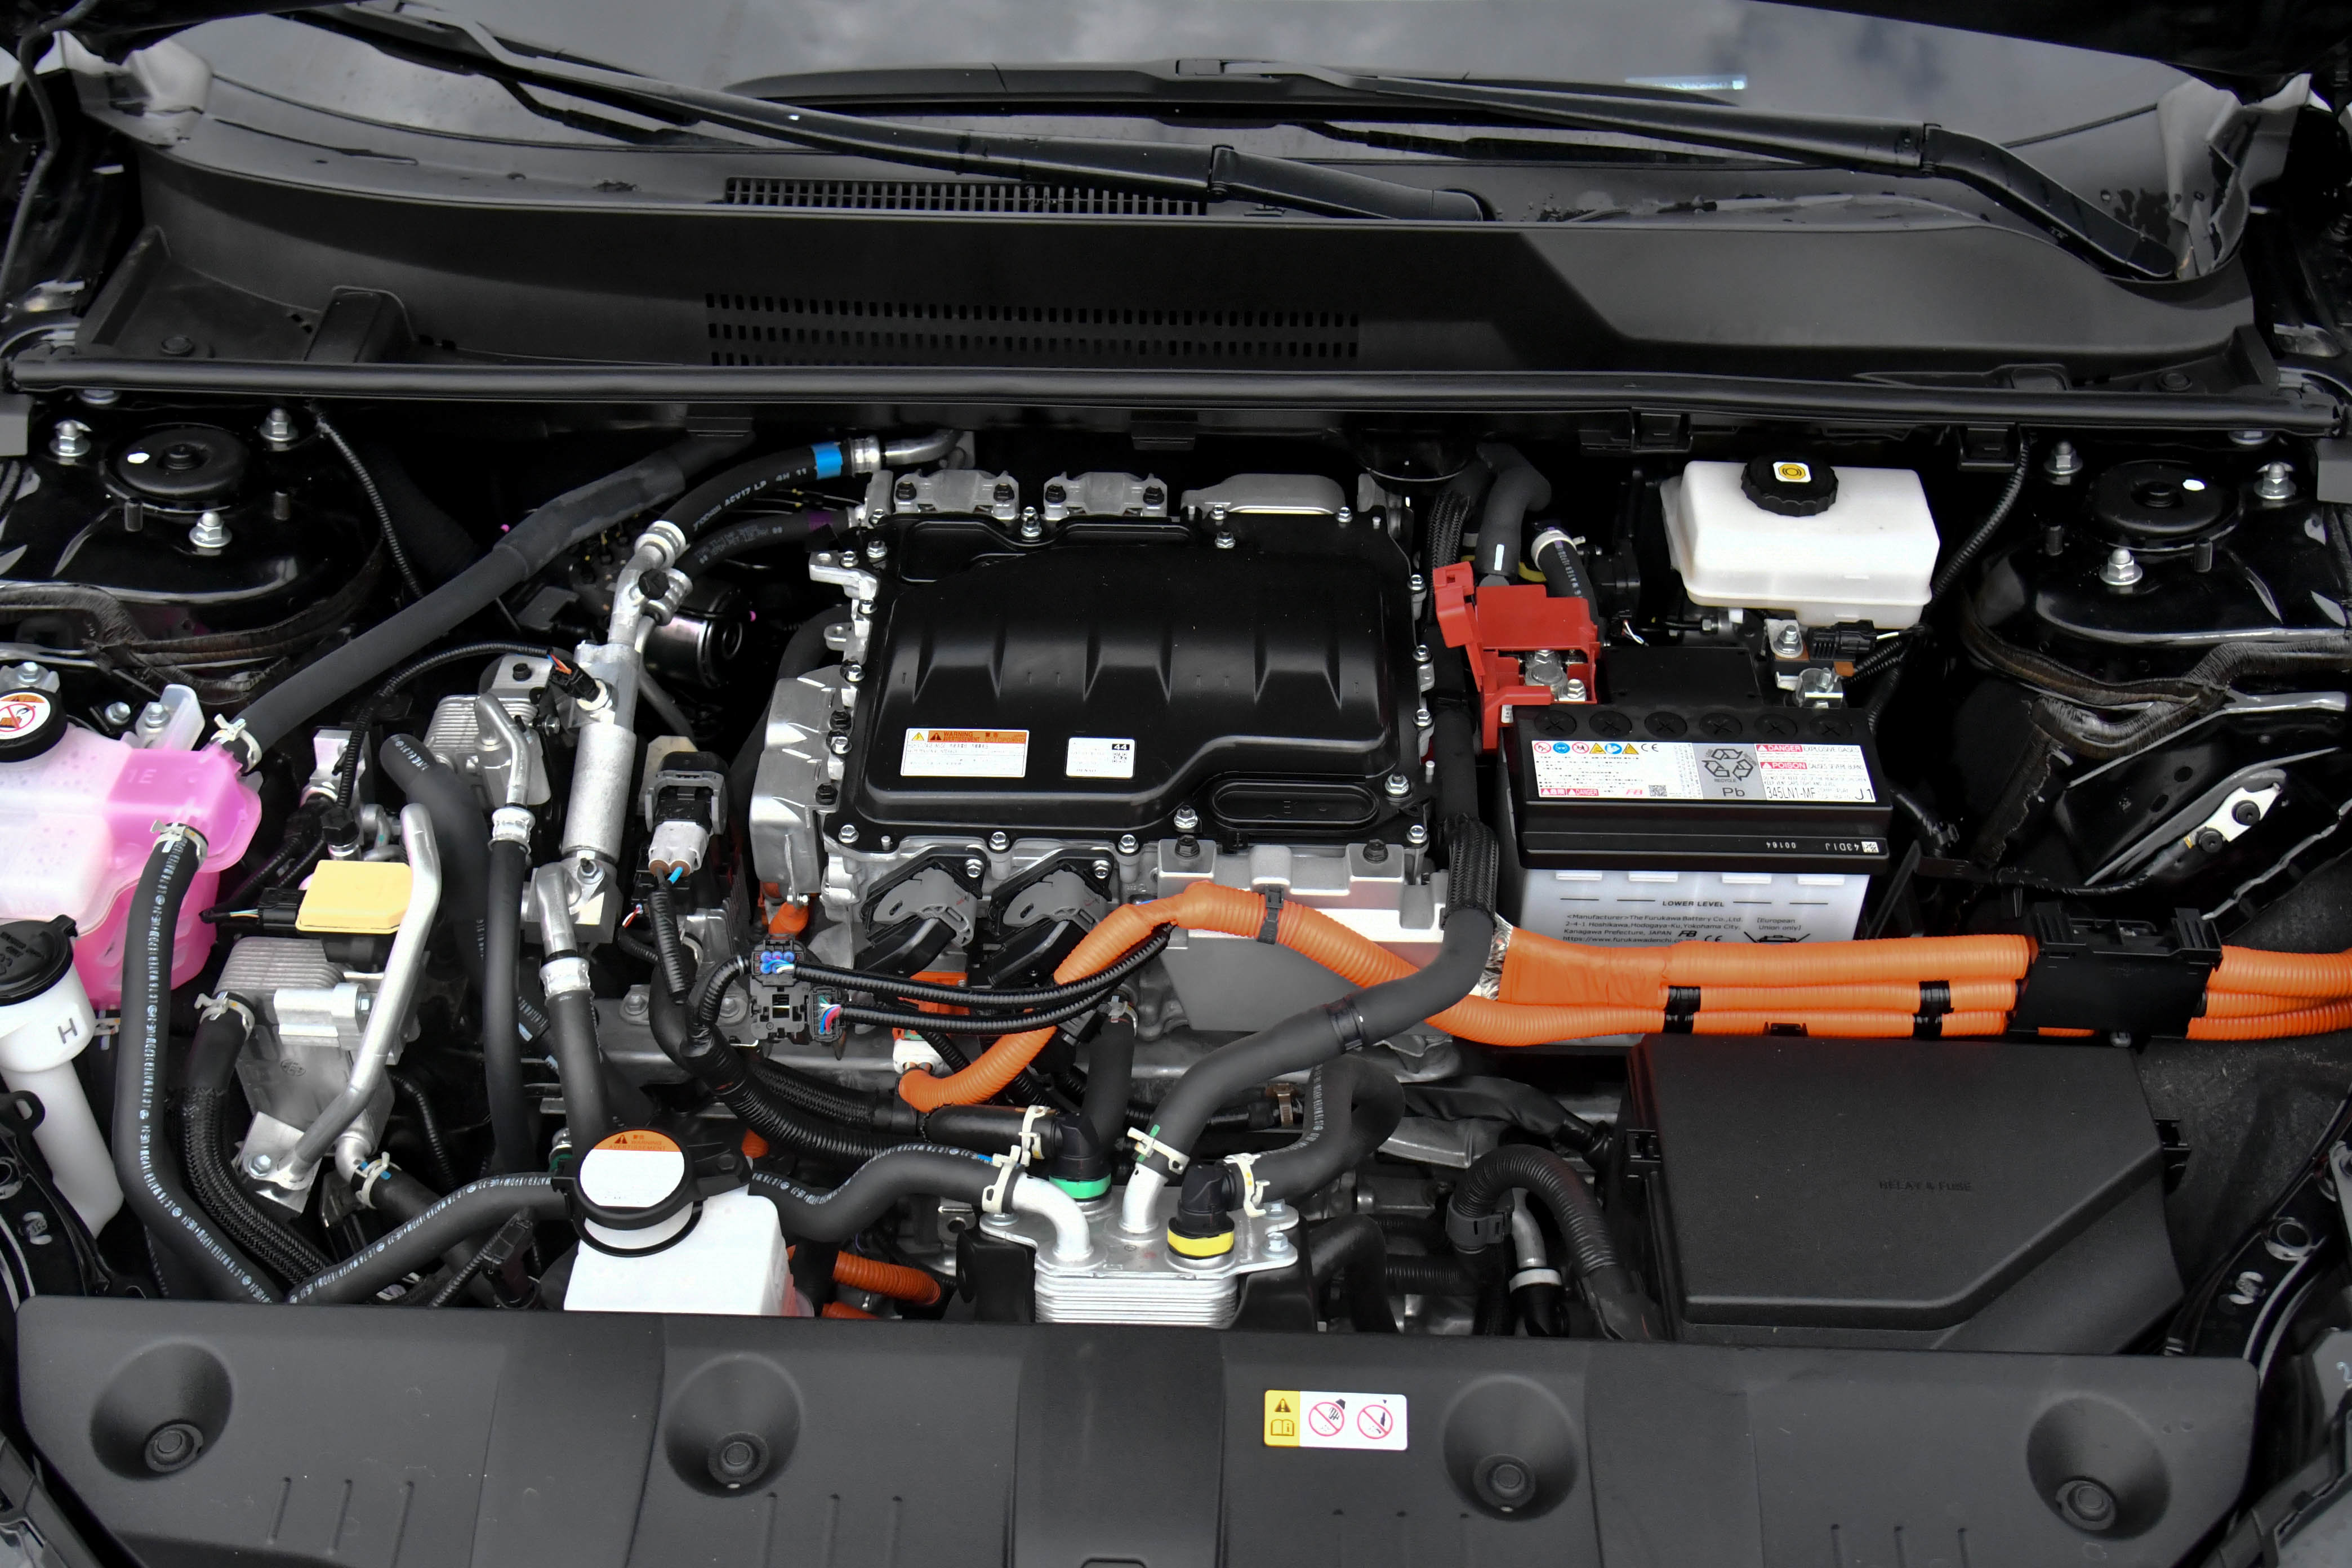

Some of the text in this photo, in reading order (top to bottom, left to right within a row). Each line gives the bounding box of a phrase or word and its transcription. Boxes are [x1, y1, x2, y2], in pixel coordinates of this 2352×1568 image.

[754, 480, 767, 491] LP
[1722, 787, 1745, 797] Pb
[1766, 786, 1816, 799] 345LN1-MF
[57, 1018, 78, 1044] H
[1879, 1180, 1921, 1191] RELAY
[1939, 1181, 1972, 1191] FUSE
